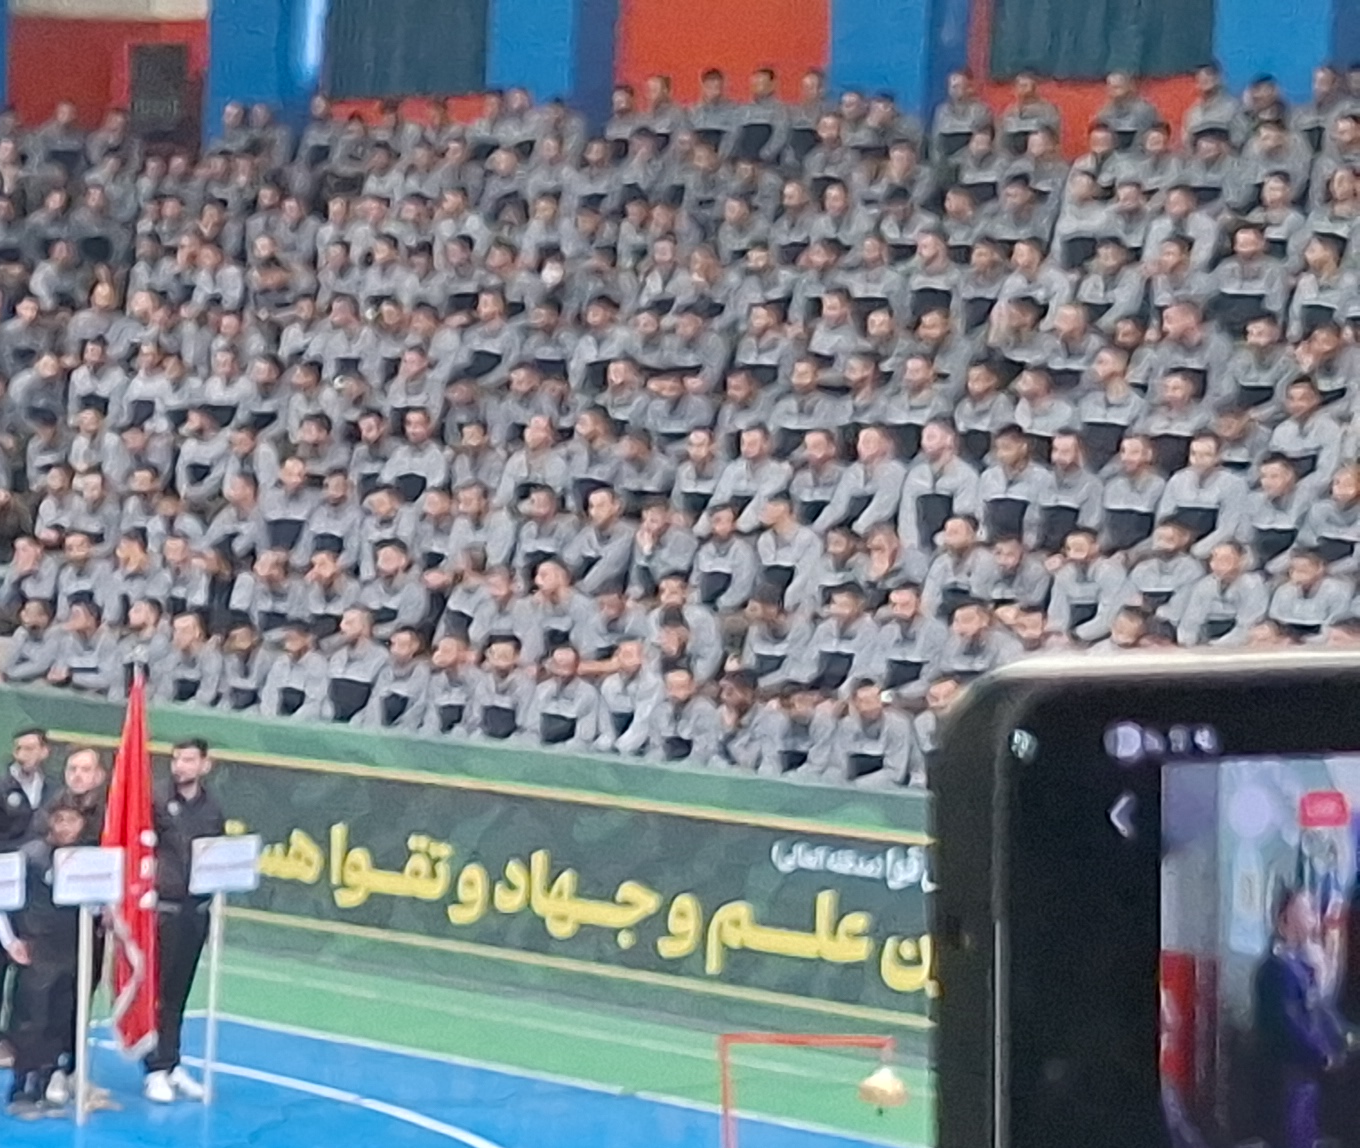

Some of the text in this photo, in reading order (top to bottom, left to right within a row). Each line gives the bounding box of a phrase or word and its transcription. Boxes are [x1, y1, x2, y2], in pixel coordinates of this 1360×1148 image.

[330, 821, 455, 908] تقوا
[447, 864, 490, 925] و
[494, 849, 663, 949] جهاد
[657, 892, 703, 959] و
[706, 889, 874, 975] علم
